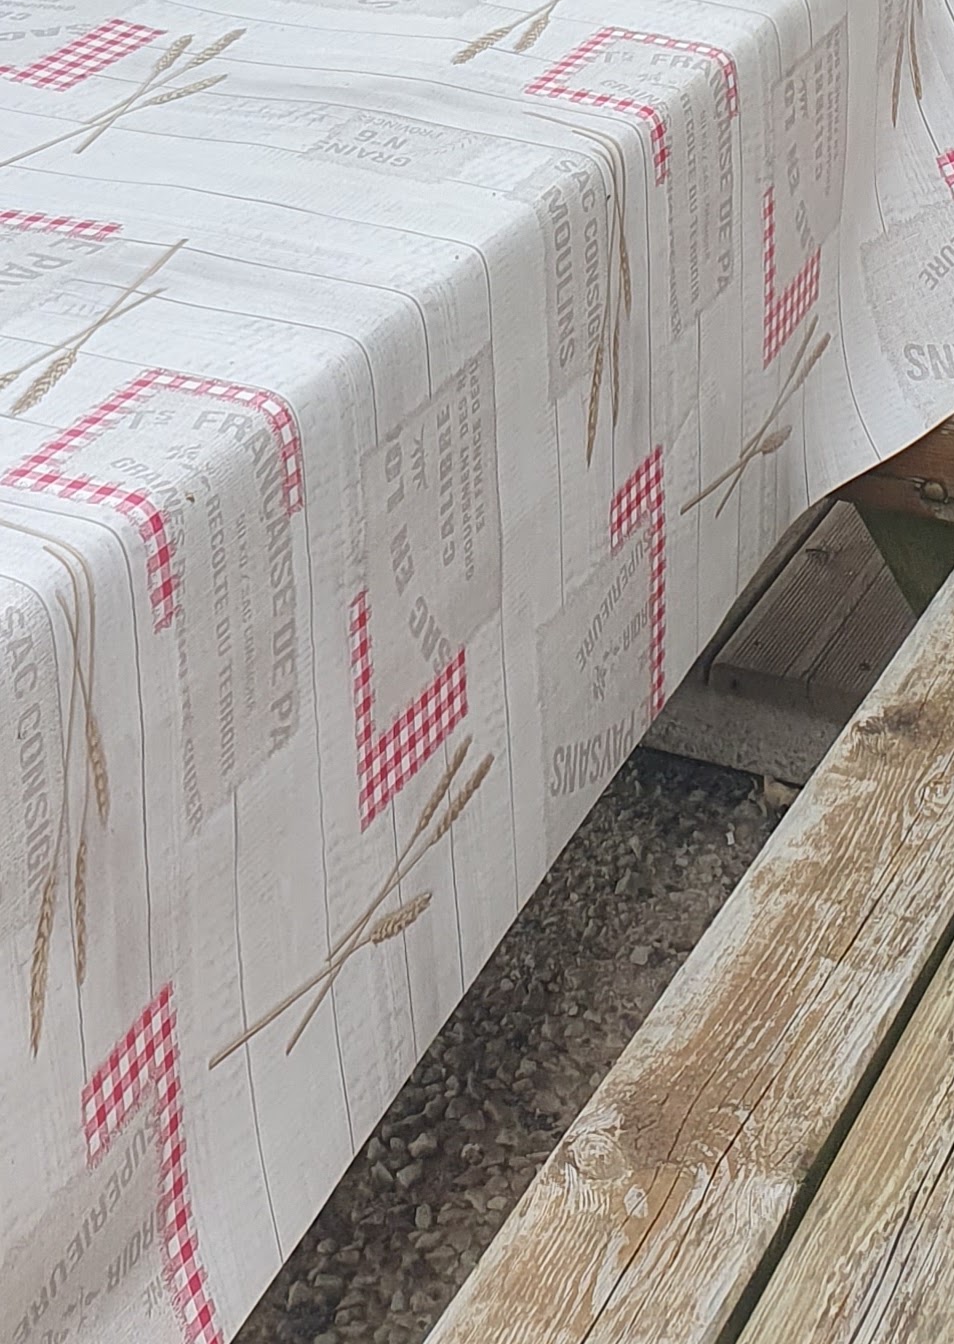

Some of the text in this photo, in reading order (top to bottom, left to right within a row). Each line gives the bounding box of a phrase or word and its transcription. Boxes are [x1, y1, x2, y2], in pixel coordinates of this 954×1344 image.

[305, 139, 412, 168] GRAINS
[554, 159, 596, 213] SAC
[651, 53, 735, 191] FRANÇAISE
[718, 198, 734, 242] DE
[542, 184, 575, 369] MOULINS
[458, 393, 470, 436] DES
[471, 415, 484, 499] FRANCE
[110, 456, 187, 559] GRAINES
[436, 402, 456, 567] CALIBRE
[459, 444, 476, 580] GROUPEMENT
[474, 503, 486, 530] EN
[191, 408, 297, 618] FRANÇAISE
[270, 625, 295, 688] DE
[389, 522, 415, 595] EN
[203, 493, 237, 778] RECOLTE DU TERROIR
[407, 594, 453, 672] SAC
[573, 528, 652, 674] SUPERIEURE
[2, 605, 38, 700] SAC
[549, 709, 635, 797] PAYSANS
[11, 1113, 159, 1344] SUPERIEURE
